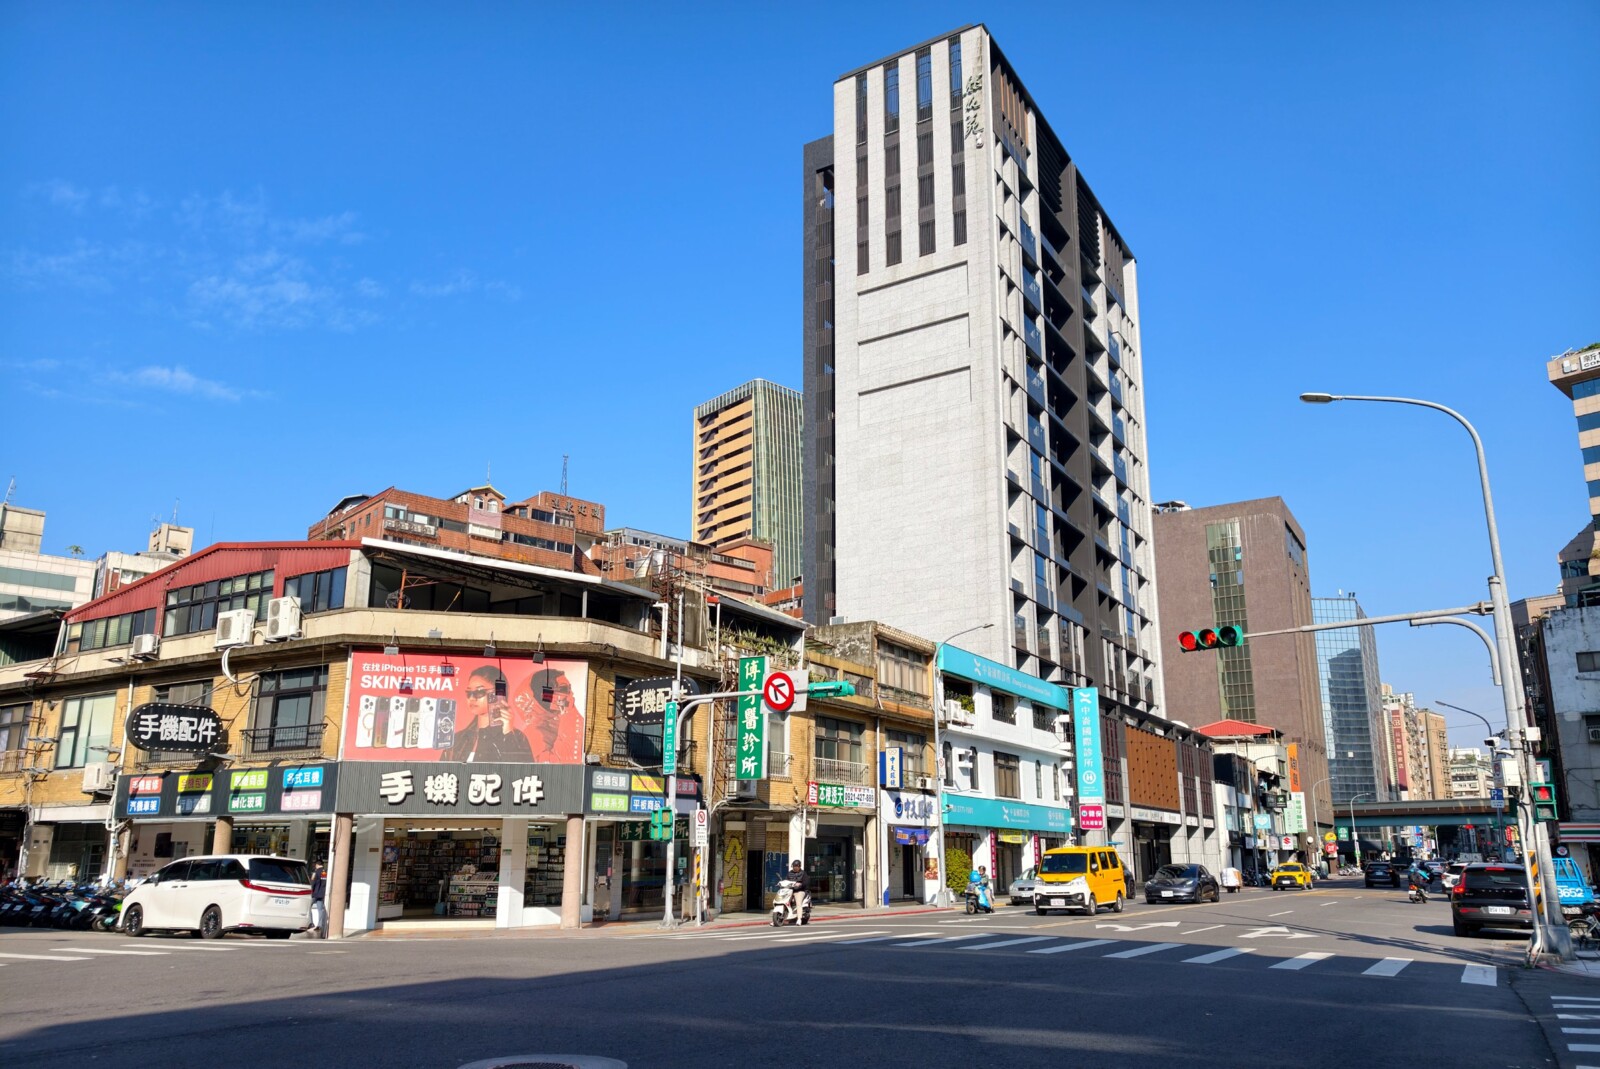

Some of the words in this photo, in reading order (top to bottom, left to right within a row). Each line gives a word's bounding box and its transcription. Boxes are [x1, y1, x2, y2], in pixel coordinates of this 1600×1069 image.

[1583, 352, 1600, 363] 新
[362, 663, 380, 672] 在找
[381, 663, 415, 673] iPhone
[416, 665, 427, 673] 15
[360, 674, 454, 692] SKINARMA
[625, 685, 689, 716] 手機配
[138, 714, 217, 744] 手機配件
[287, 771, 320, 784] 各式耳機
[379, 769, 544, 804] 手機配件
